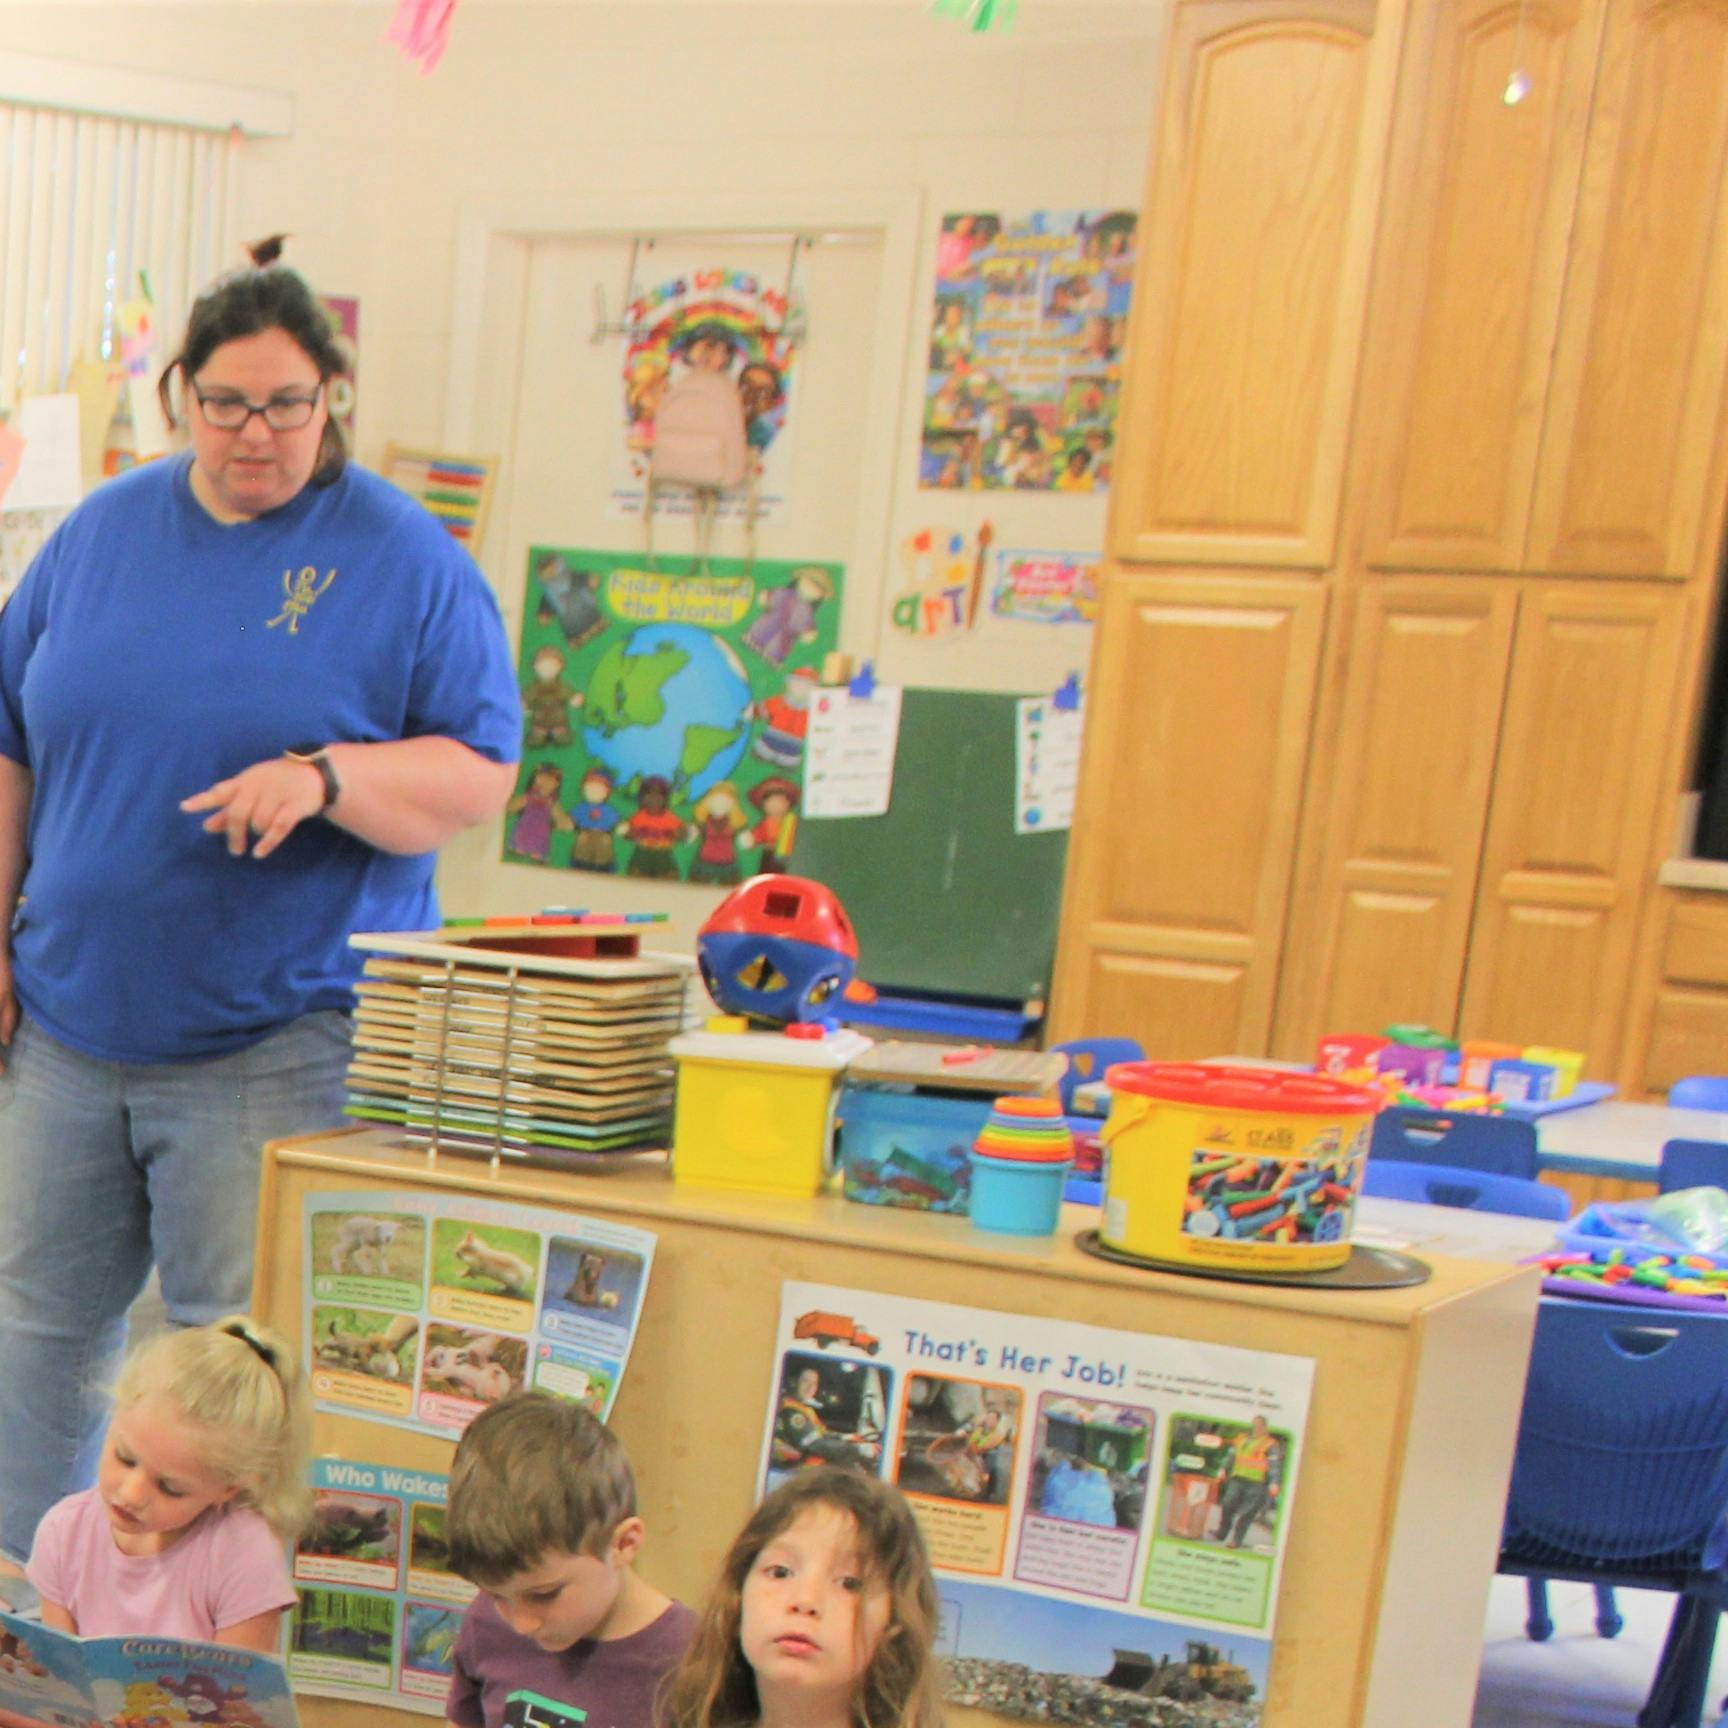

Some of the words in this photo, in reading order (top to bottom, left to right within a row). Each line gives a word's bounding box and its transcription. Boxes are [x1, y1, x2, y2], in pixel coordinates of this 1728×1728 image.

[903, 1329, 989, 1368] That's
[999, 1347, 1053, 1375] Her
[1060, 1353, 1127, 1390] Job!
[326, 1464, 376, 1489] Who
